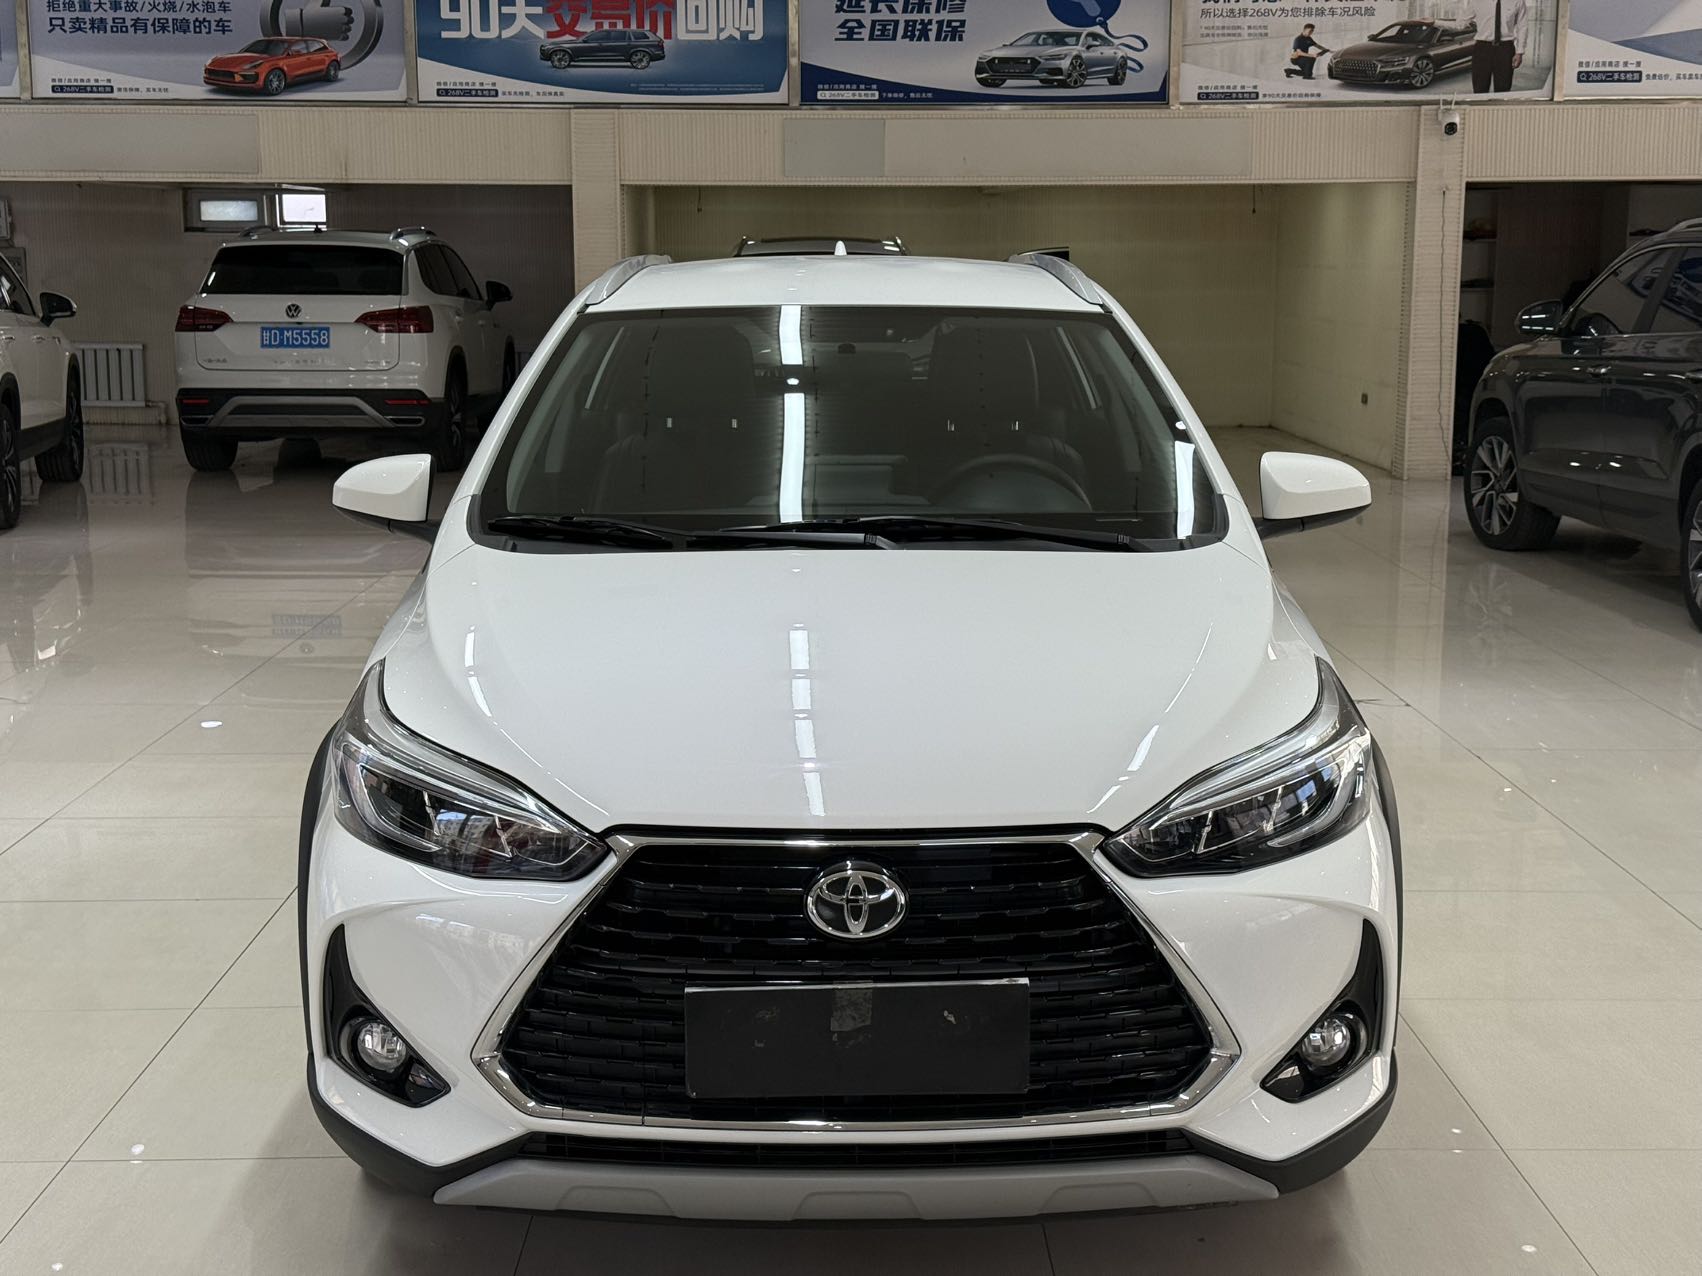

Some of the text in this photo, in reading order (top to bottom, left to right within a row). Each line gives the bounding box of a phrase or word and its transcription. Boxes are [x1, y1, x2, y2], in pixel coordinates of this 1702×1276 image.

[47, 0, 232, 13] 拒绝重大事故/火烧/水泡车
[1200, 6, 1377, 19] 所以选择268V为您排除车况风险
[48, 17, 233, 35] 只卖精品有保障的车
[834, 18, 967, 42] 全国联保
